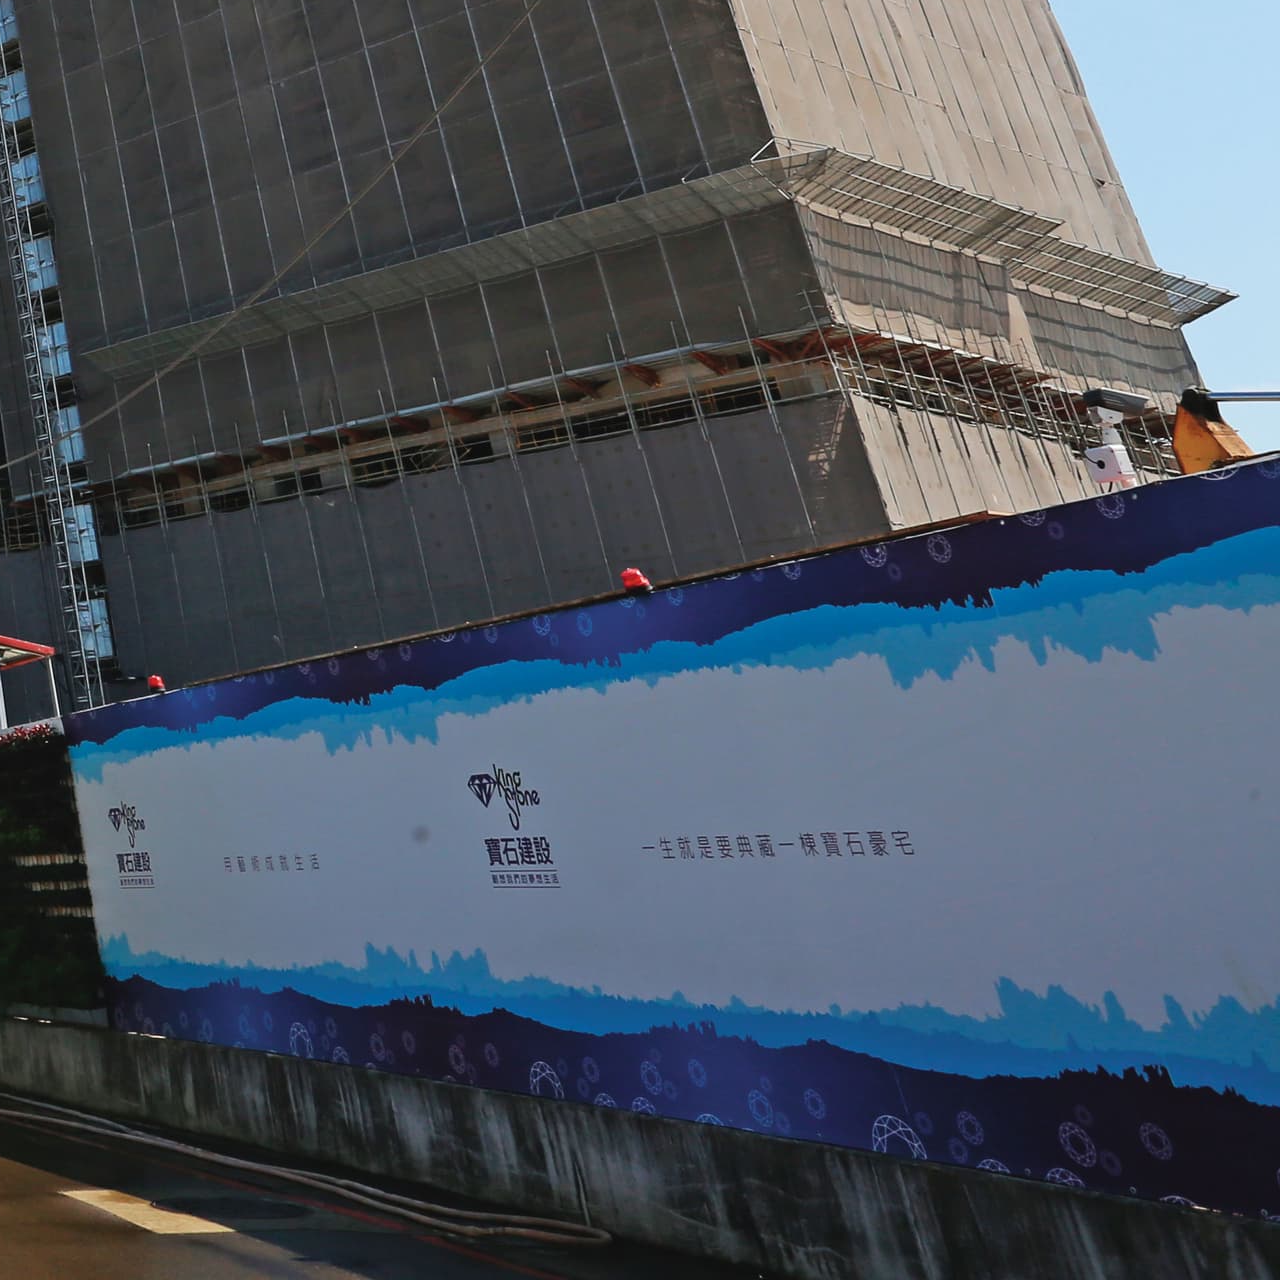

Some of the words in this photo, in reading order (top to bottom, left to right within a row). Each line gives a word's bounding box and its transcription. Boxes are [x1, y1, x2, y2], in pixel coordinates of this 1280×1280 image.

[484, 836, 553, 866] 寶石建設
[641, 830, 915, 860] 一生就是要典藏一棟寶石豪宅
